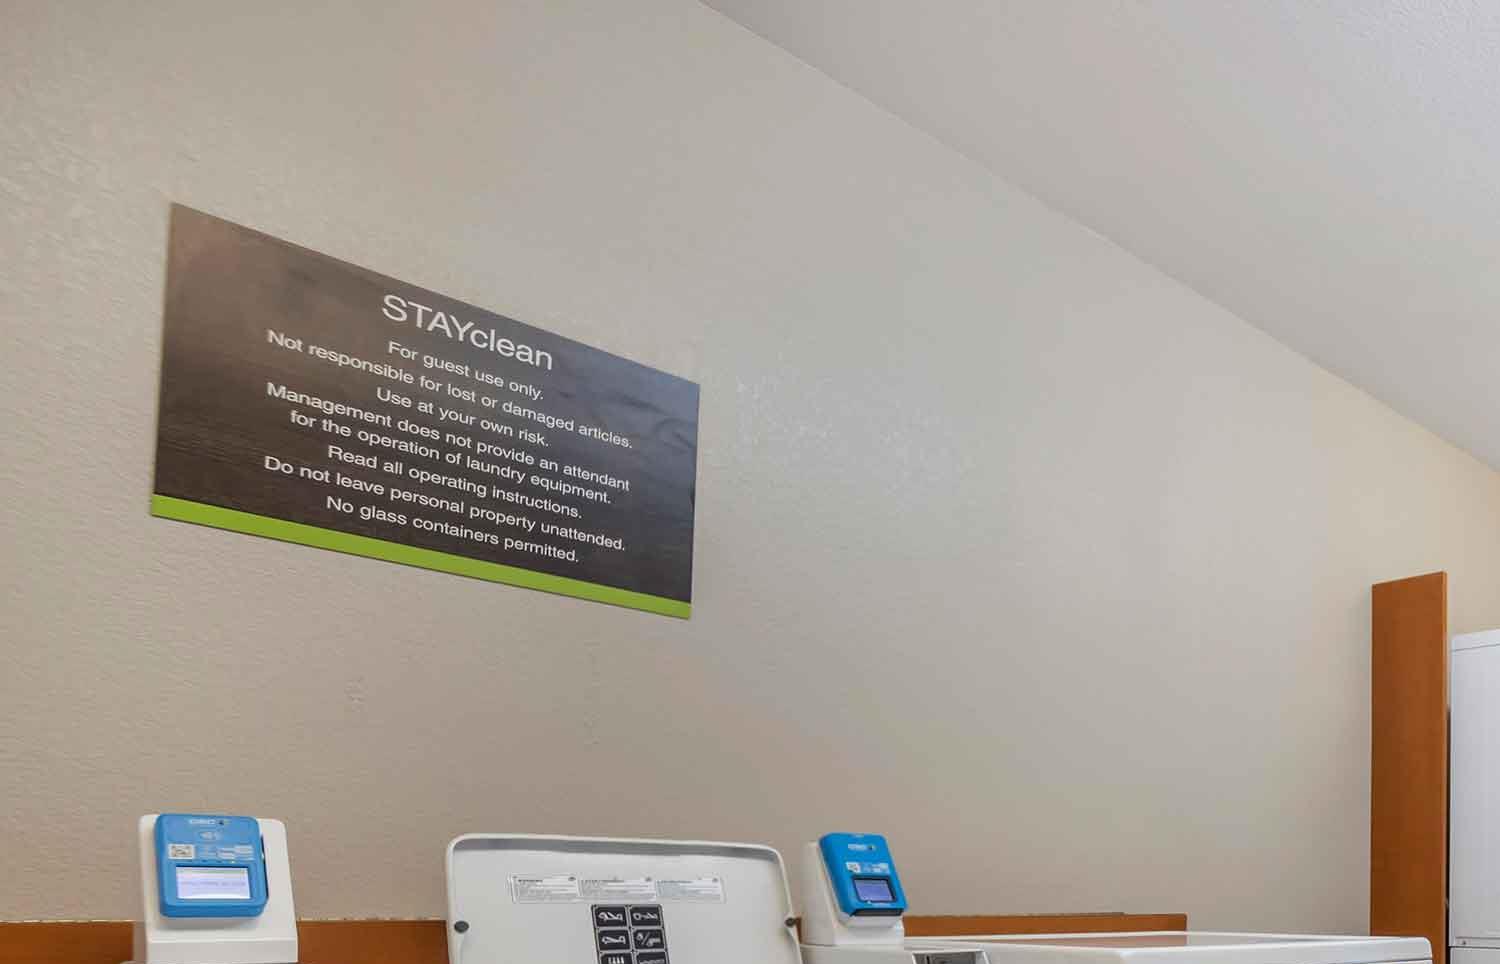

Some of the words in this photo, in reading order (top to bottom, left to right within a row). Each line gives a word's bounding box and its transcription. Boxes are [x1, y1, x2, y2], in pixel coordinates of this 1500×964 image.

[382, 294, 553, 371] STAYclean
[388, 340, 419, 361] For
[423, 354, 470, 377] guest
[475, 370, 504, 388] use
[509, 381, 544, 401] only.
[266, 329, 303, 353] Not
[308, 344, 414, 384] responsible
[420, 375, 443, 393] for
[447, 383, 476, 403] lost
[481, 396, 499, 409] or
[502, 401, 575, 432] damaged
[578, 424, 633, 449] articles.
[376, 386, 412, 408] Use
[417, 401, 434, 415] at
[439, 407, 478, 426] your
[480, 419, 513, 437] own
[519, 428, 549, 447] risk.
[266, 381, 393, 428] Management
[397, 419, 441, 441] does
[446, 432, 473, 449] not
[476, 441, 535, 466] provide
[539, 458, 559, 473] an
[563, 464, 630, 492] attendant
[290, 409, 317, 428] for
[321, 419, 353, 437] the
[357, 430, 440, 461] operation
[445, 452, 462, 465] of
[466, 455, 526, 484] laundry
[530, 474, 611, 504] equipment.
[264, 455, 294, 475] Do
[300, 466, 331, 484] not
[336, 472, 385, 496] leave
[390, 487, 465, 514] personal
[469, 505, 536, 533] property
[540, 522, 625, 552] unattended.
[327, 444, 378, 470] Read
[383, 460, 404, 475] all
[408, 468, 488, 499] operating
[492, 485, 582, 520] instructions.
[326, 495, 354, 514] No
[359, 504, 408, 526] glass
[412, 518, 499, 546] containers
[504, 537, 579, 563] permitted.
